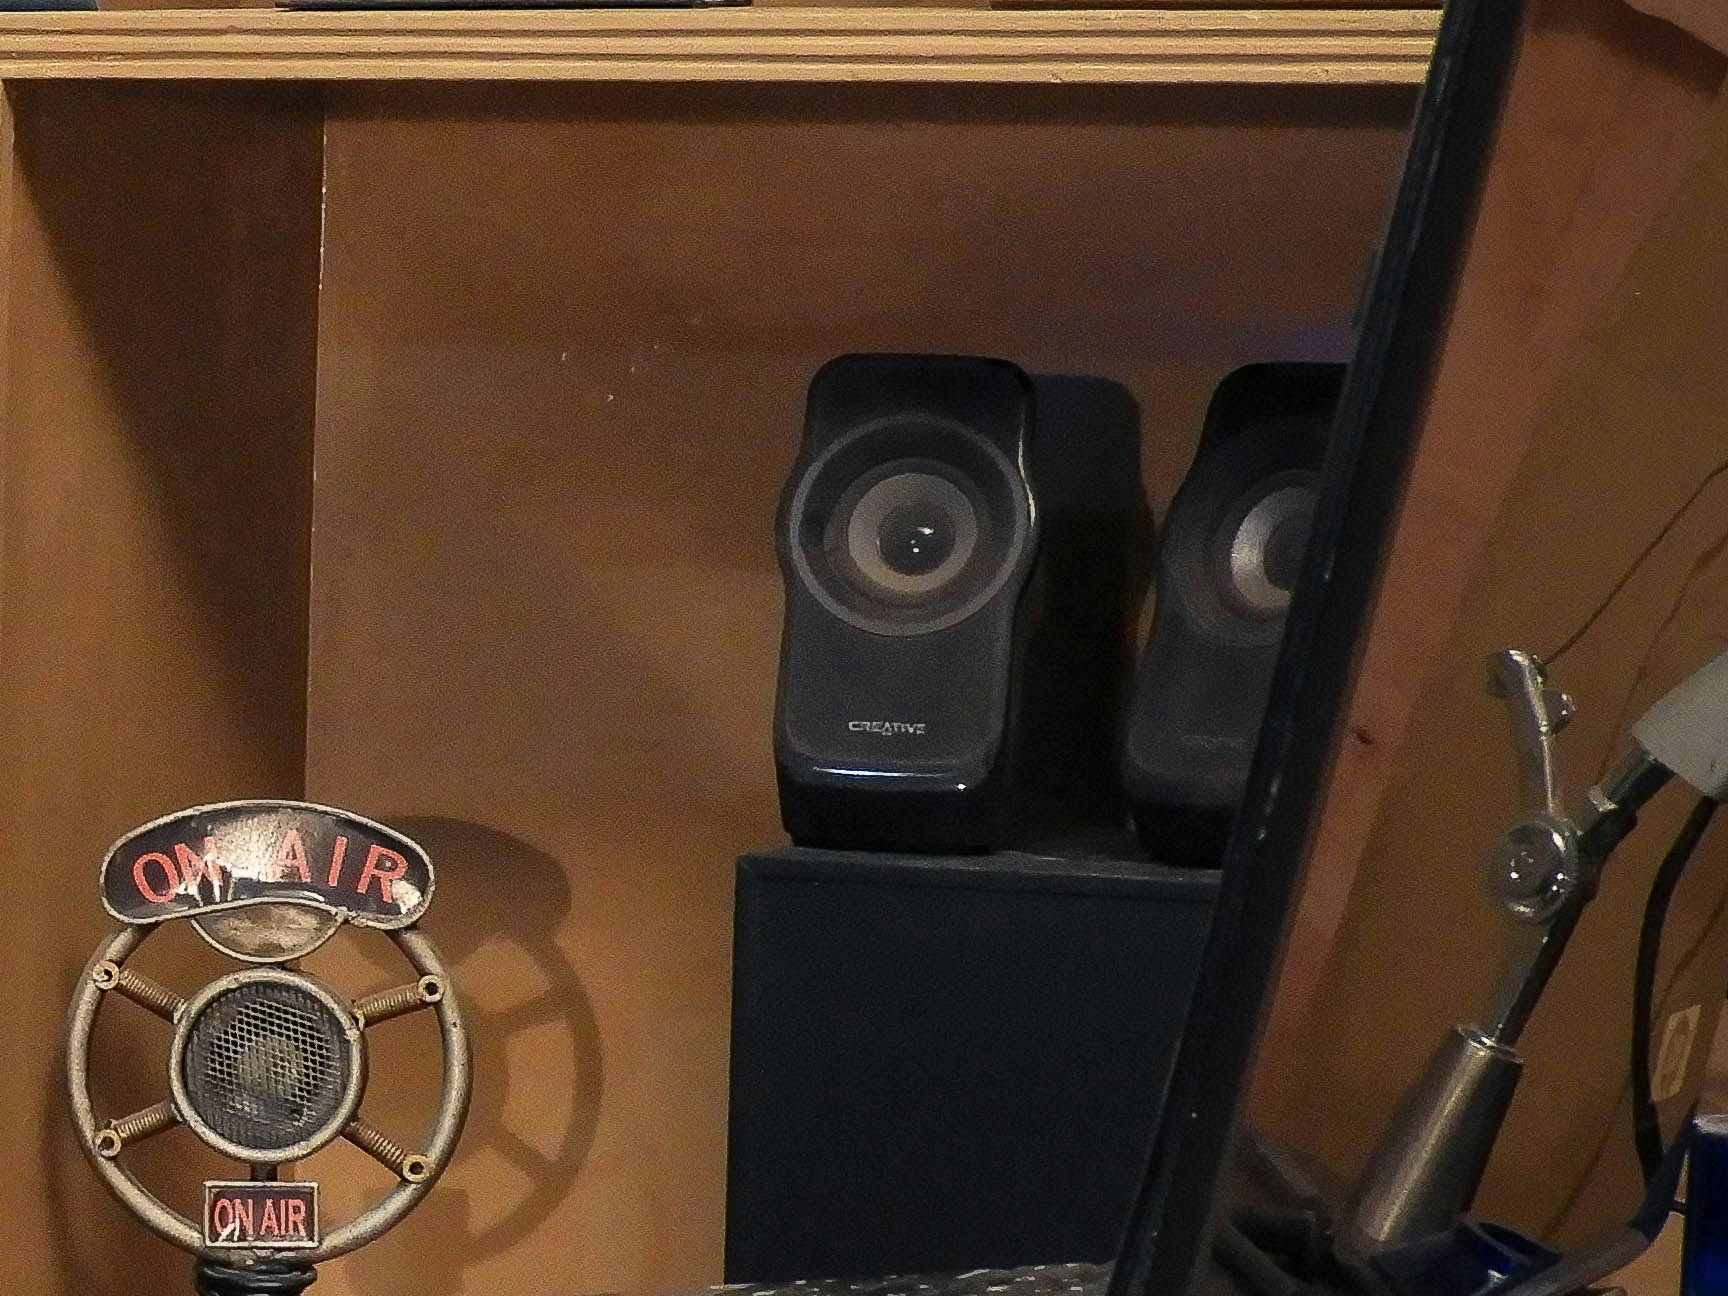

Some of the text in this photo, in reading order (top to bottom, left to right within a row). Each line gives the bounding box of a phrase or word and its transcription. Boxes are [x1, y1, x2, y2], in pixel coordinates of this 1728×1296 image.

[848, 721, 926, 735] CREATIVE
[132, 830, 408, 904] ON AIR
[214, 1198, 306, 1236] ON AIR
